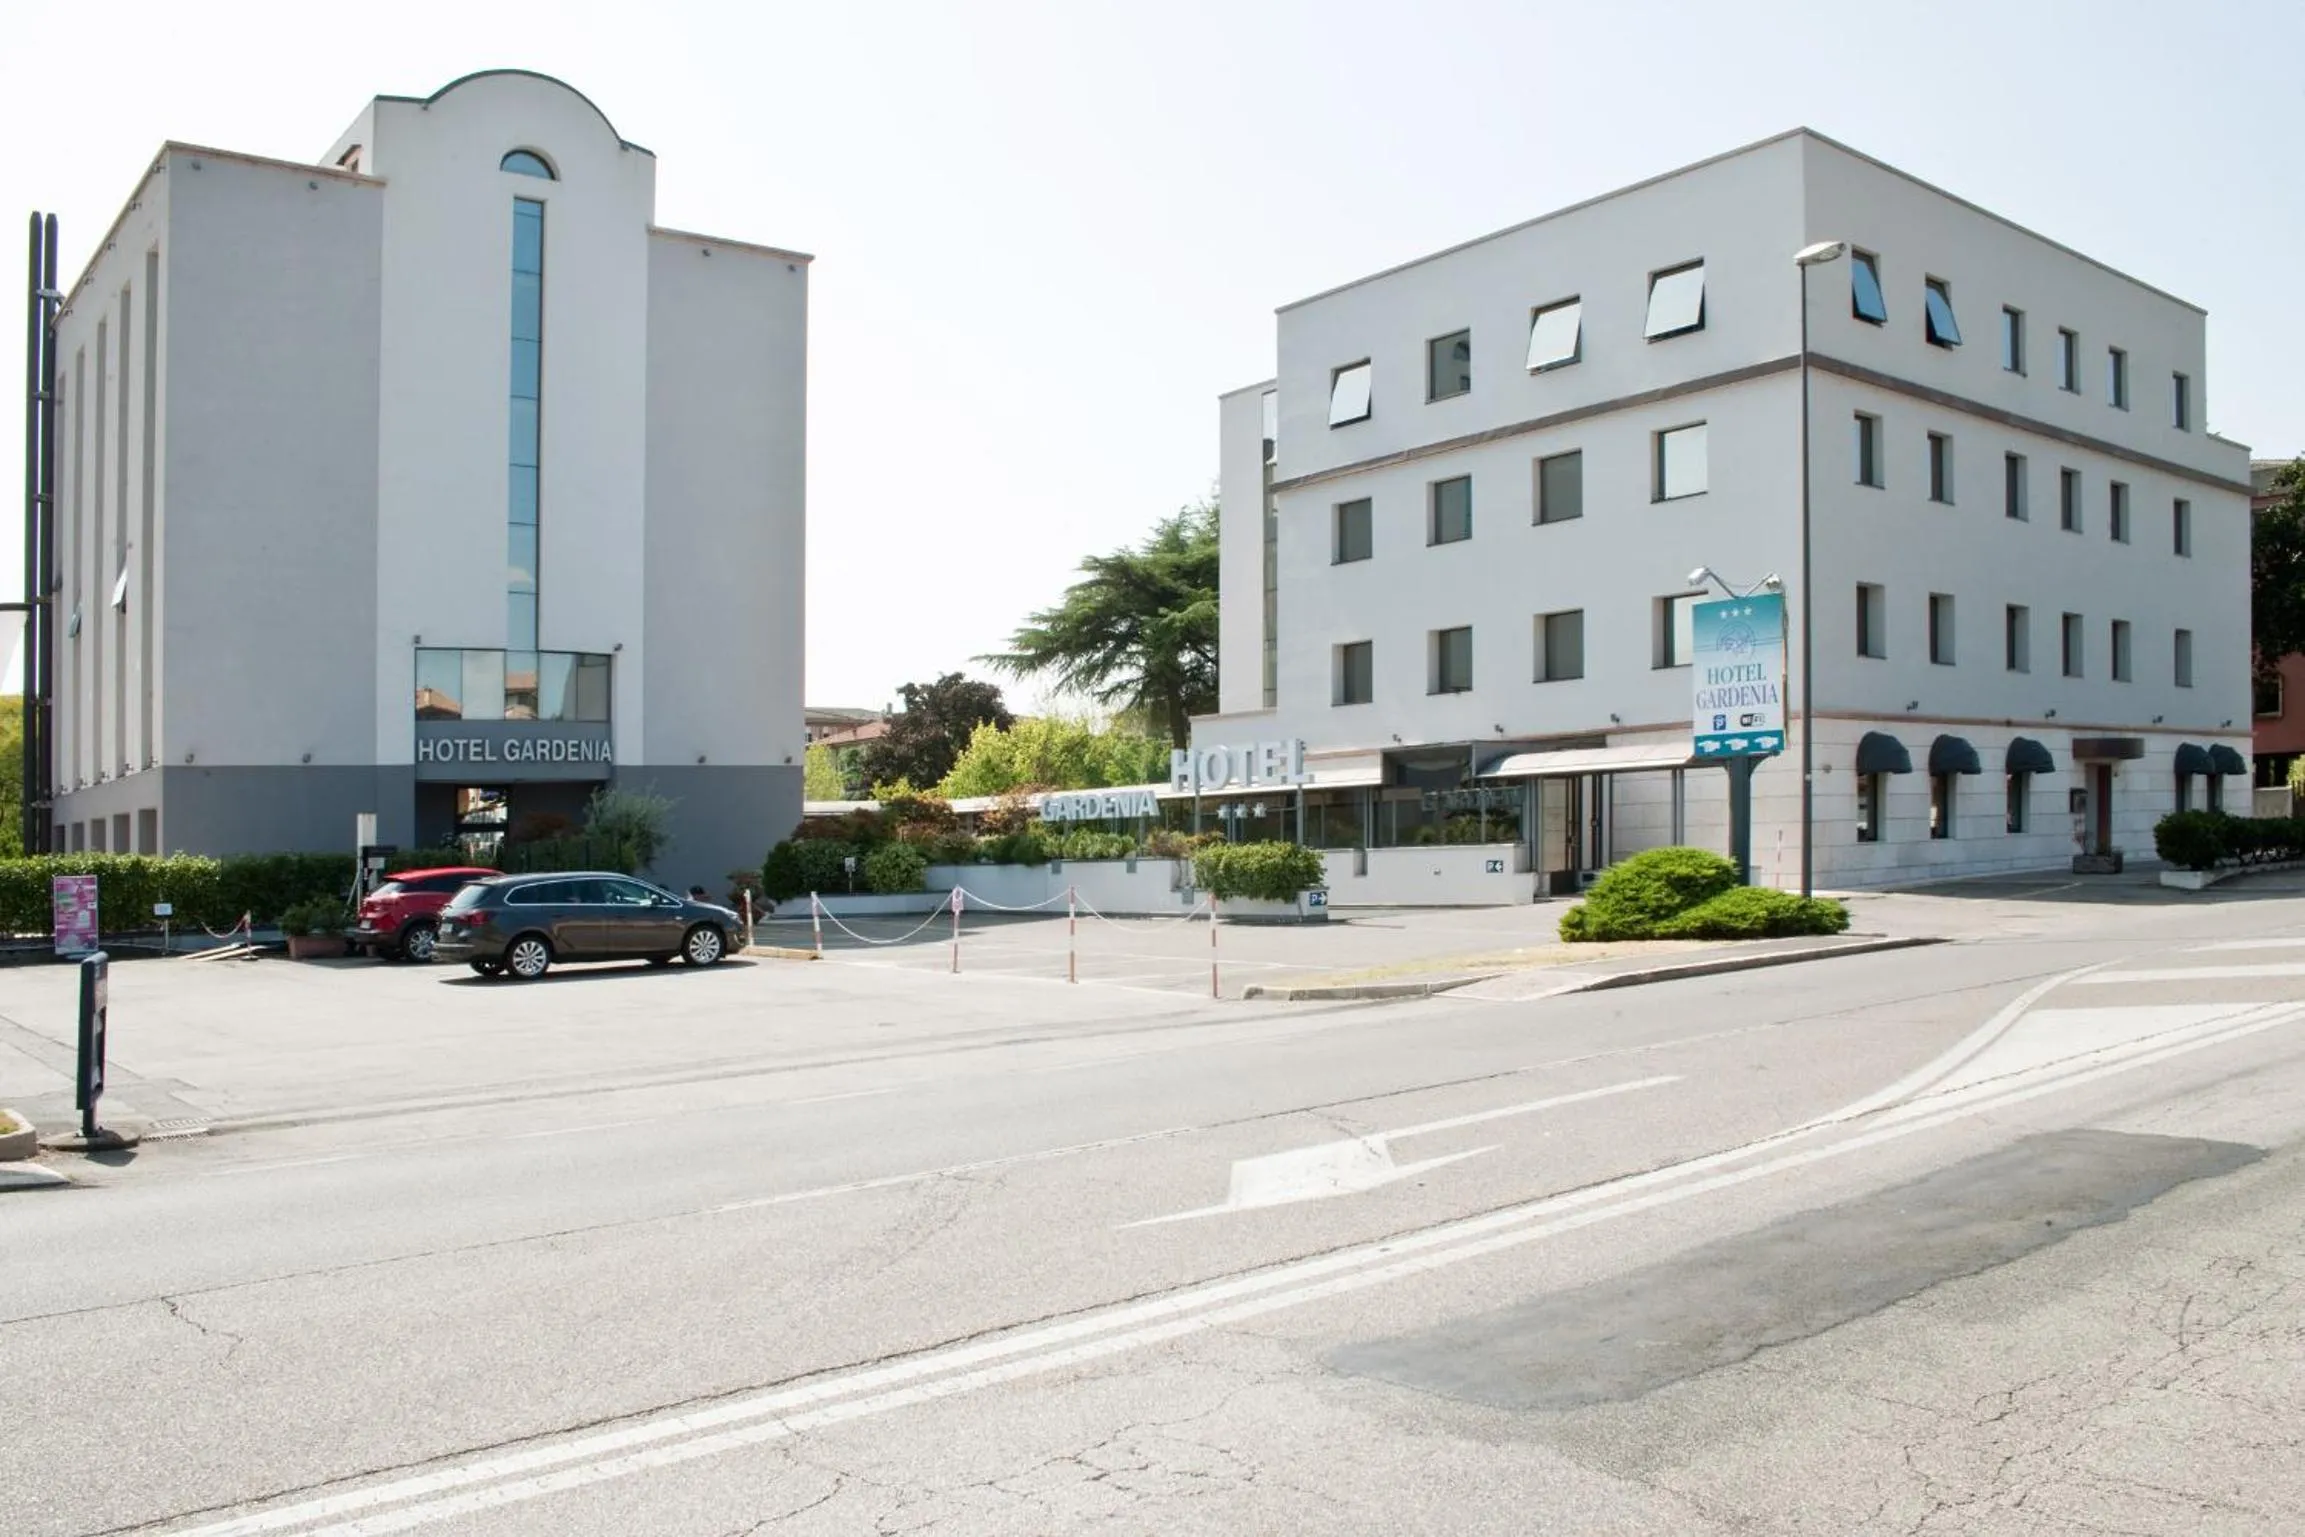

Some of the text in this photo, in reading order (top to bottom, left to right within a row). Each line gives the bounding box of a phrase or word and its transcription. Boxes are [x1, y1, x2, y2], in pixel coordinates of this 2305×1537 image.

[1707, 663, 1767, 685] HOTEL
[1695, 683, 1778, 710] GARDENIA
[418, 738, 612, 761] HOTEL GARDENIA
[1170, 738, 1315, 793] HOTEL
[1039, 789, 1160, 822] GARDENIA
